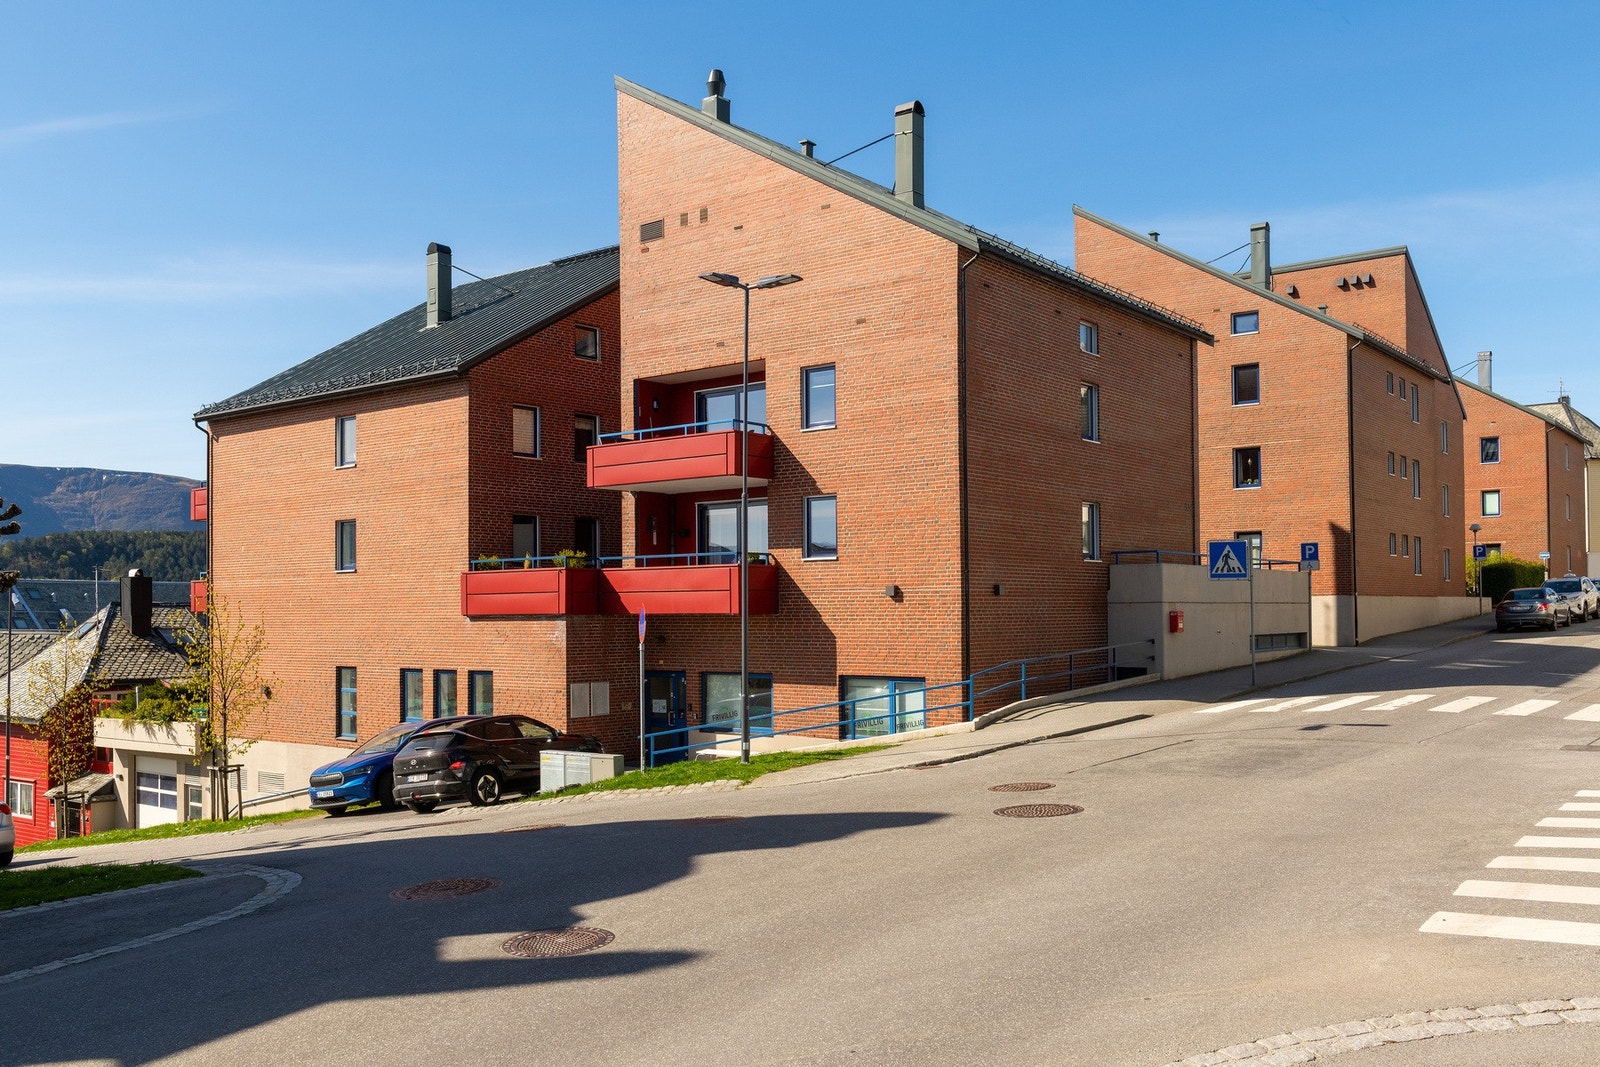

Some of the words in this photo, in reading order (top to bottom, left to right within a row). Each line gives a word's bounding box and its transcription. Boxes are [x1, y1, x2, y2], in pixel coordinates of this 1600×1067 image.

[1305, 545, 1315, 559] P
[1475, 546, 1484, 556] P
[712, 710, 739, 722] FRIVILLIG
[896, 719, 925, 730] FRIVILLIG
